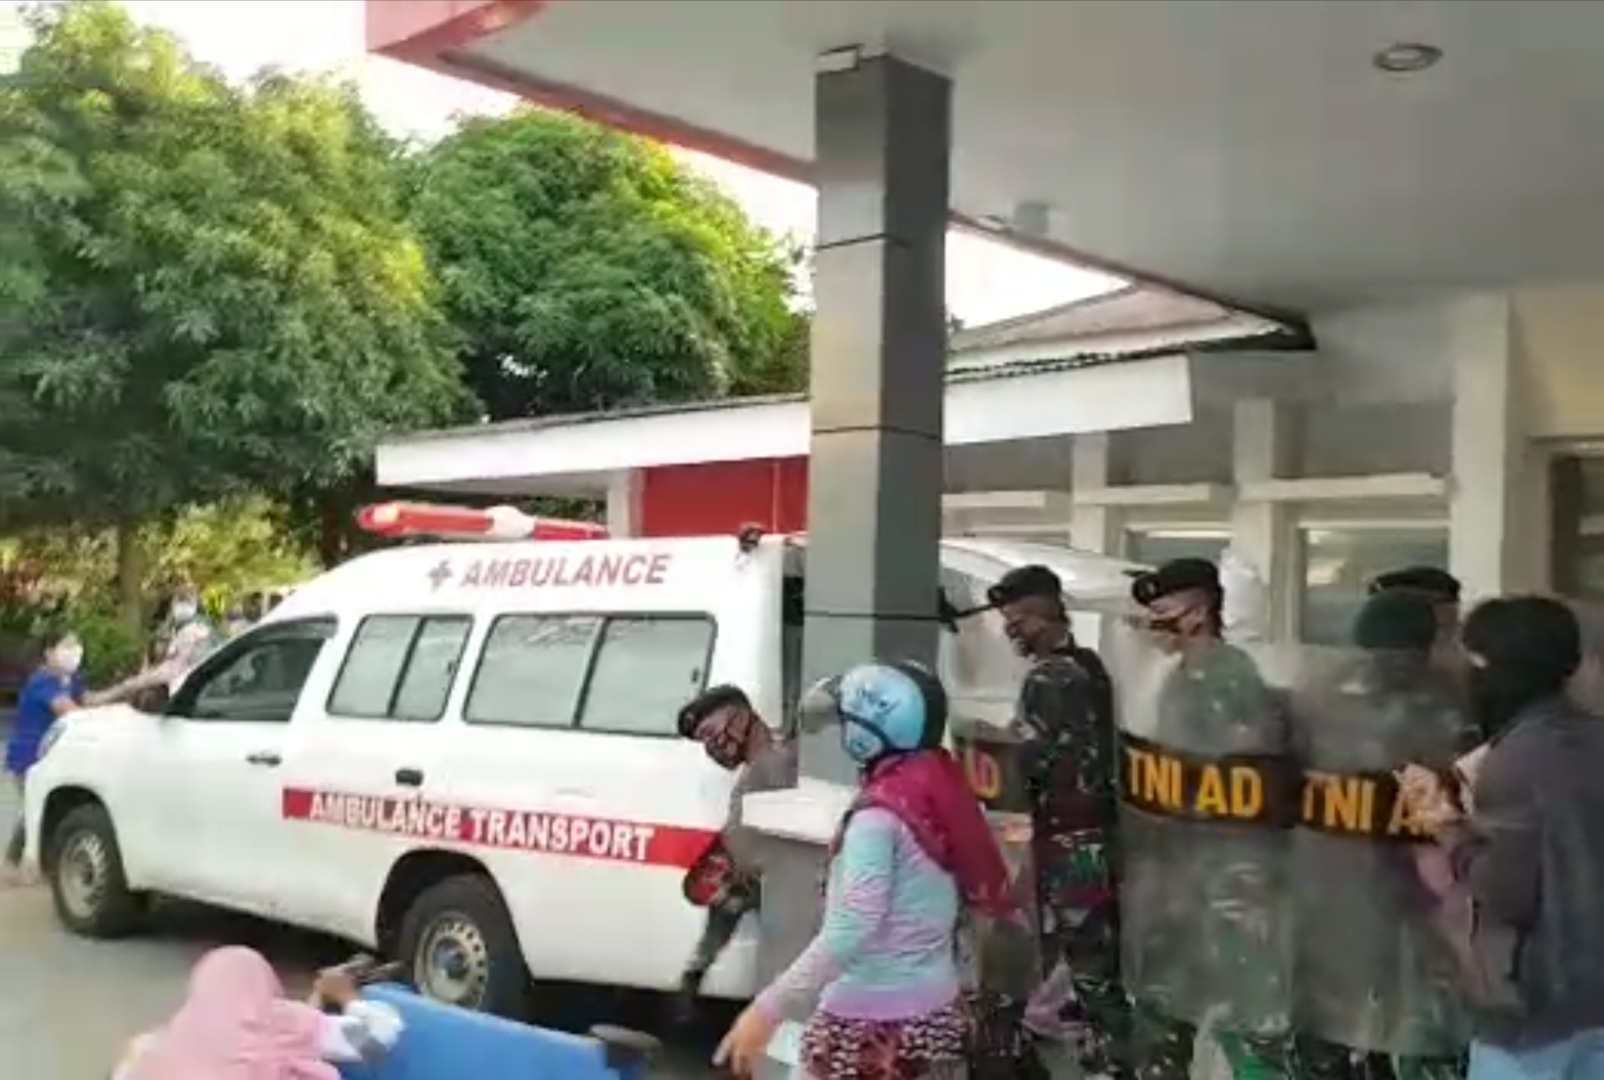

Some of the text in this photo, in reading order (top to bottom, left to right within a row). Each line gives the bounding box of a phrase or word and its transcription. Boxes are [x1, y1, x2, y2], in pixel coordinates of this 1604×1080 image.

[460, 553, 671, 589] AMBULANCE
[1126, 749, 1262, 818] TNI AD
[1302, 768, 1375, 832] TNI
[309, 792, 655, 861] AMBULANCE TRANSPORT
